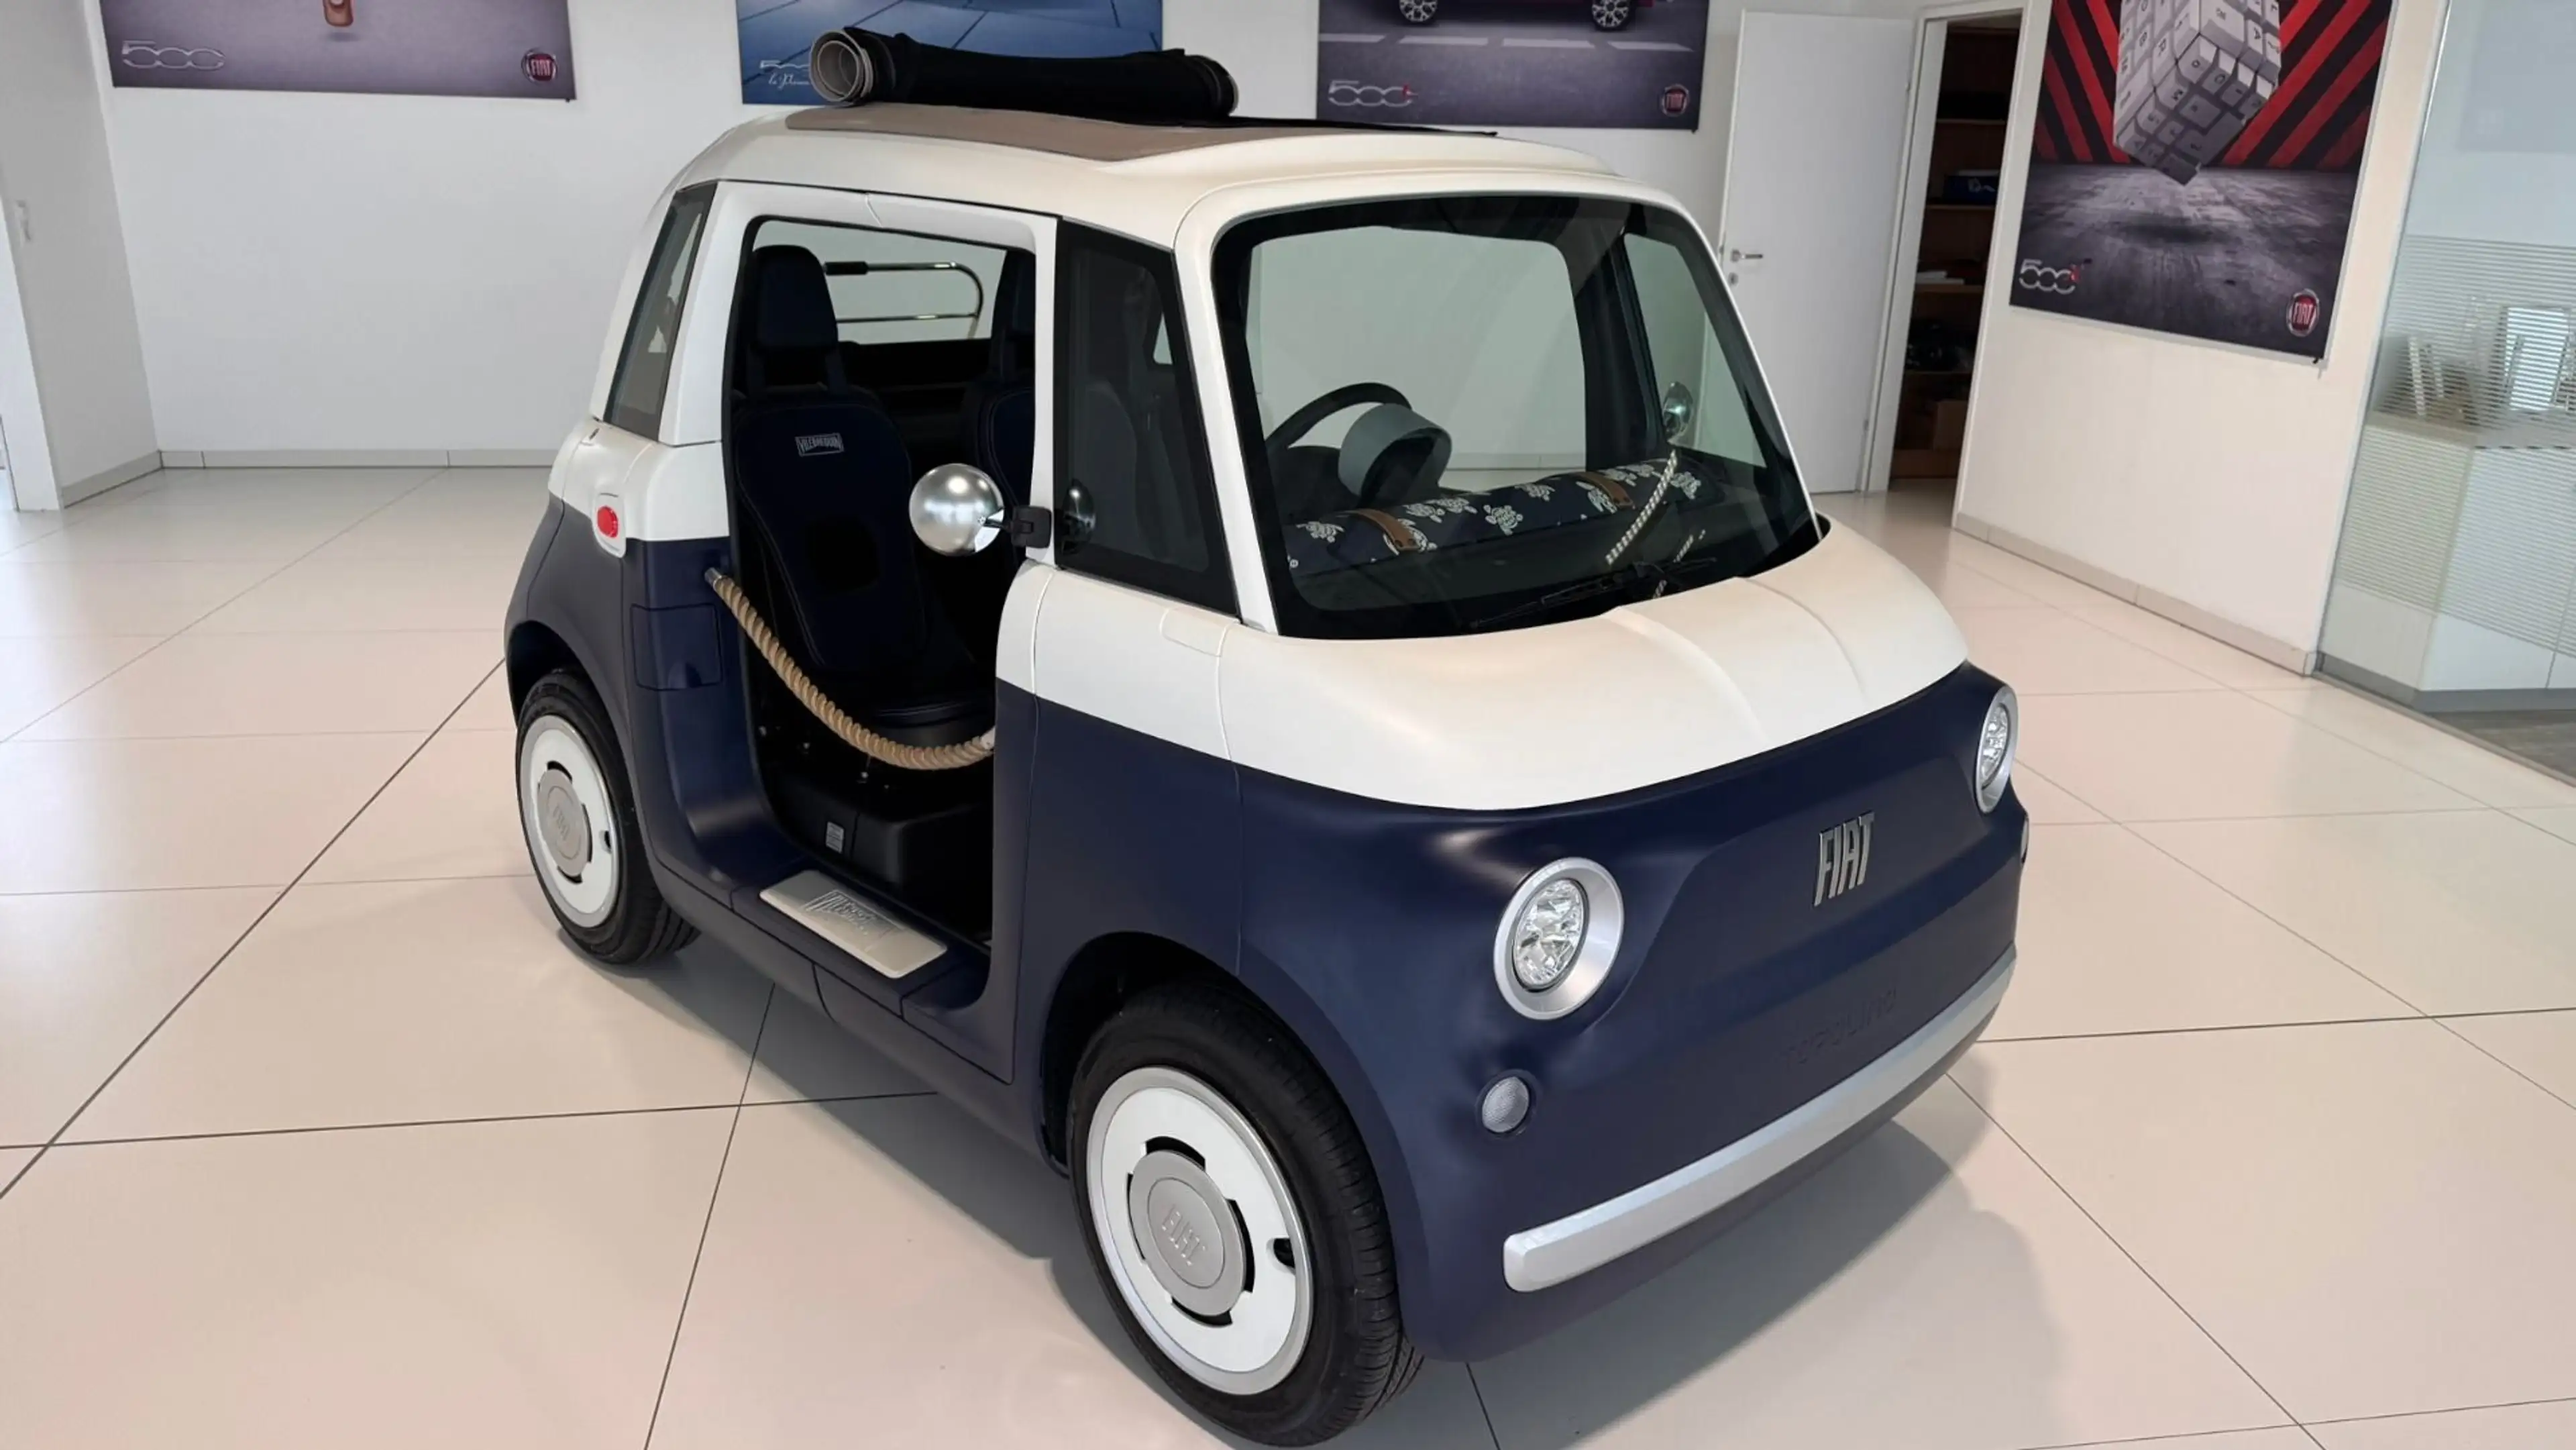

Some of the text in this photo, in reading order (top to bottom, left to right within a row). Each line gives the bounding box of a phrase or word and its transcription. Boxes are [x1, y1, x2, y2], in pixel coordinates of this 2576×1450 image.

[121, 40, 225, 71] 500
[531, 58, 551, 76] FIAT
[2293, 302, 2314, 325] FIAT
[1813, 811, 1875, 907] FIAT
